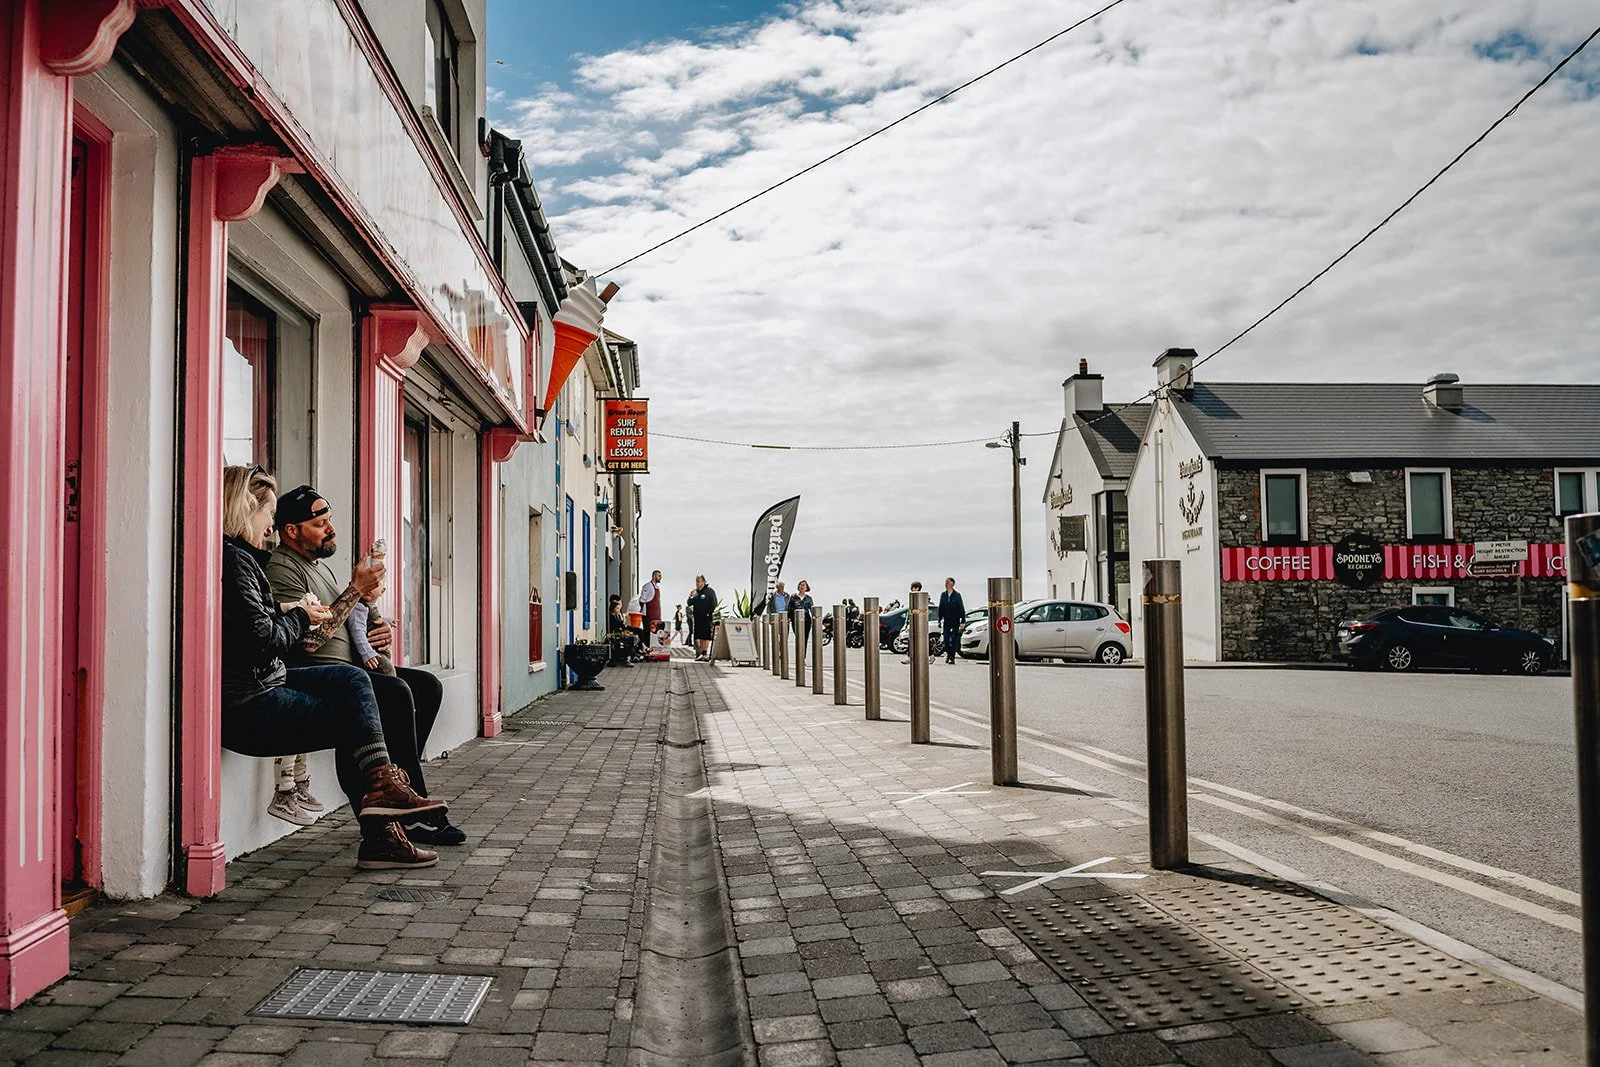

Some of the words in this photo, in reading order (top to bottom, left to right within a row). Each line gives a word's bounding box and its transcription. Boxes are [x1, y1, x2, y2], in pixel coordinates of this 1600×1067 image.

[617, 418, 636, 427] SURF
[610, 428, 644, 436] RENTALS
[617, 439, 636, 447] SURF
[610, 448, 644, 457] LESSONS
[1246, 556, 1310, 570] COFFEE
[1412, 554, 1449, 568] FISH
[1453, 554, 1465, 568] &
